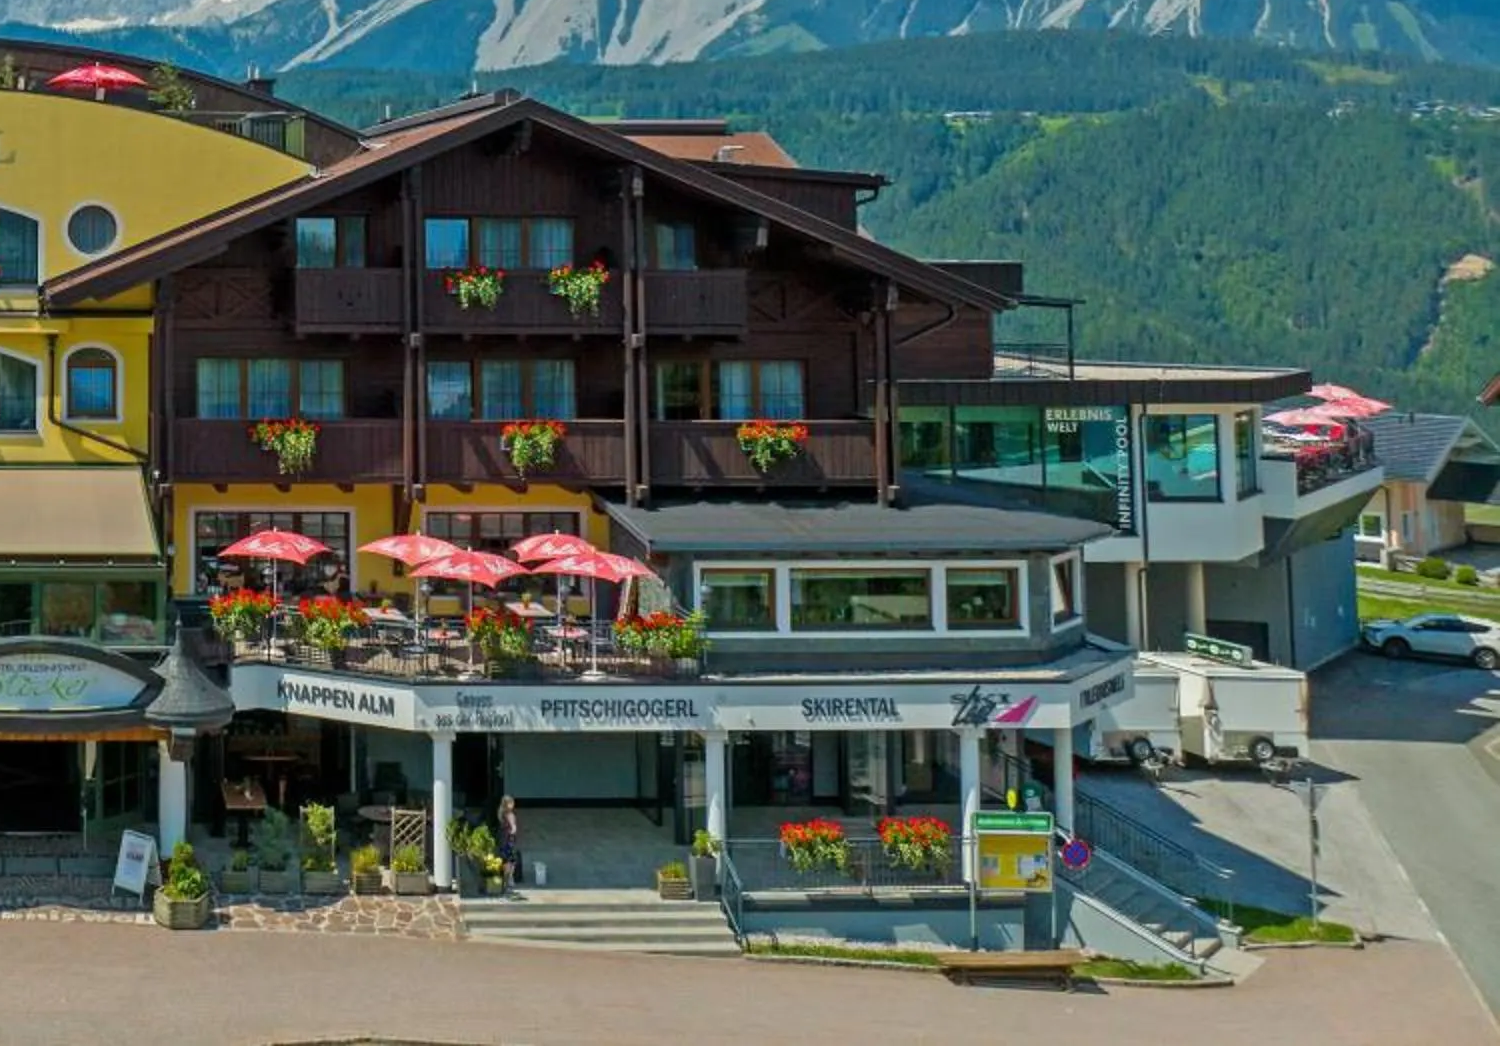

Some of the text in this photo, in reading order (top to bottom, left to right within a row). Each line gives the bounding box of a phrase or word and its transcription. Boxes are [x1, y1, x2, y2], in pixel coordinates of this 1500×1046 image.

[1045, 409, 1113, 422] ERLEBNIS
[1047, 422, 1079, 433] WELT
[277, 678, 395, 718] KNAPPEN ALM
[540, 698, 700, 718] PFITSCHIGOGERL
[801, 697, 900, 718] SKIRENTAL
